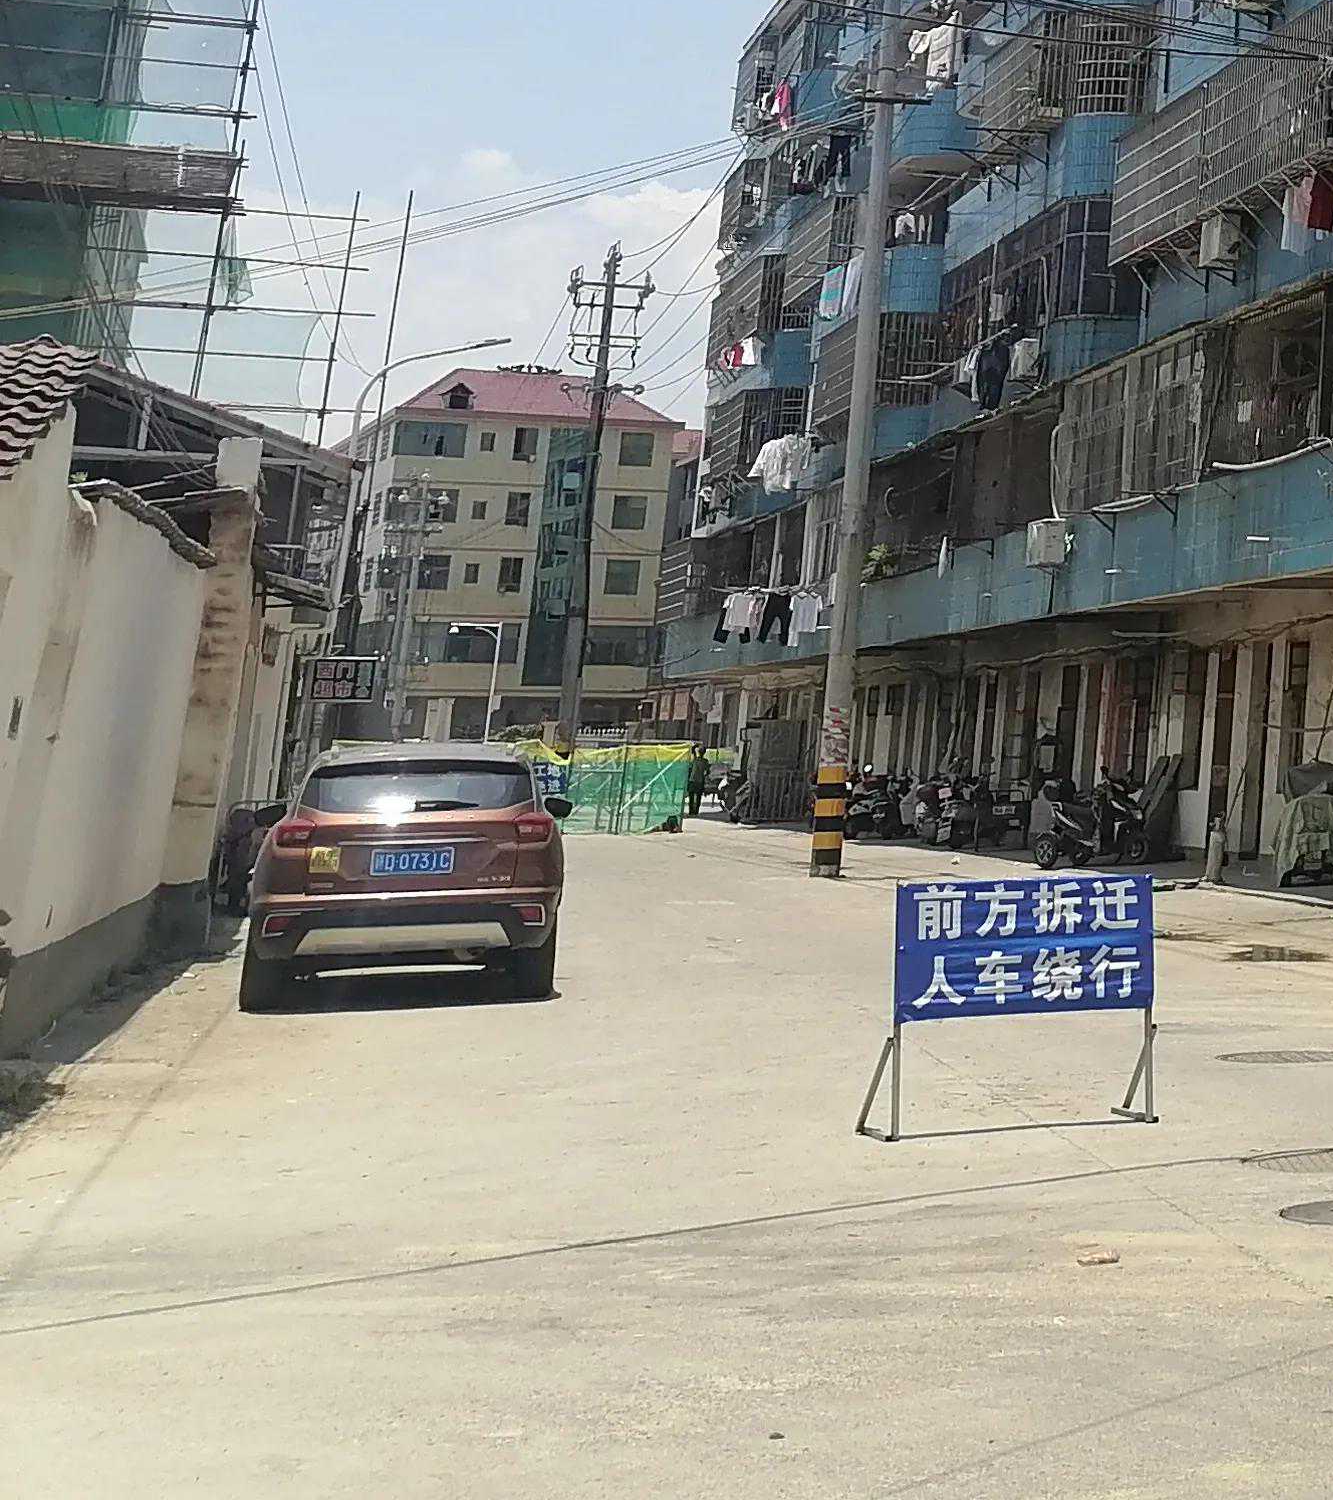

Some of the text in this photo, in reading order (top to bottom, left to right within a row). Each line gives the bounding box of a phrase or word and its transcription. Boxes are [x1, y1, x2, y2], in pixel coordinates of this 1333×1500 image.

[913, 878, 1140, 941] 前方拆迁
[911, 944, 1141, 1009] 人车绕行
